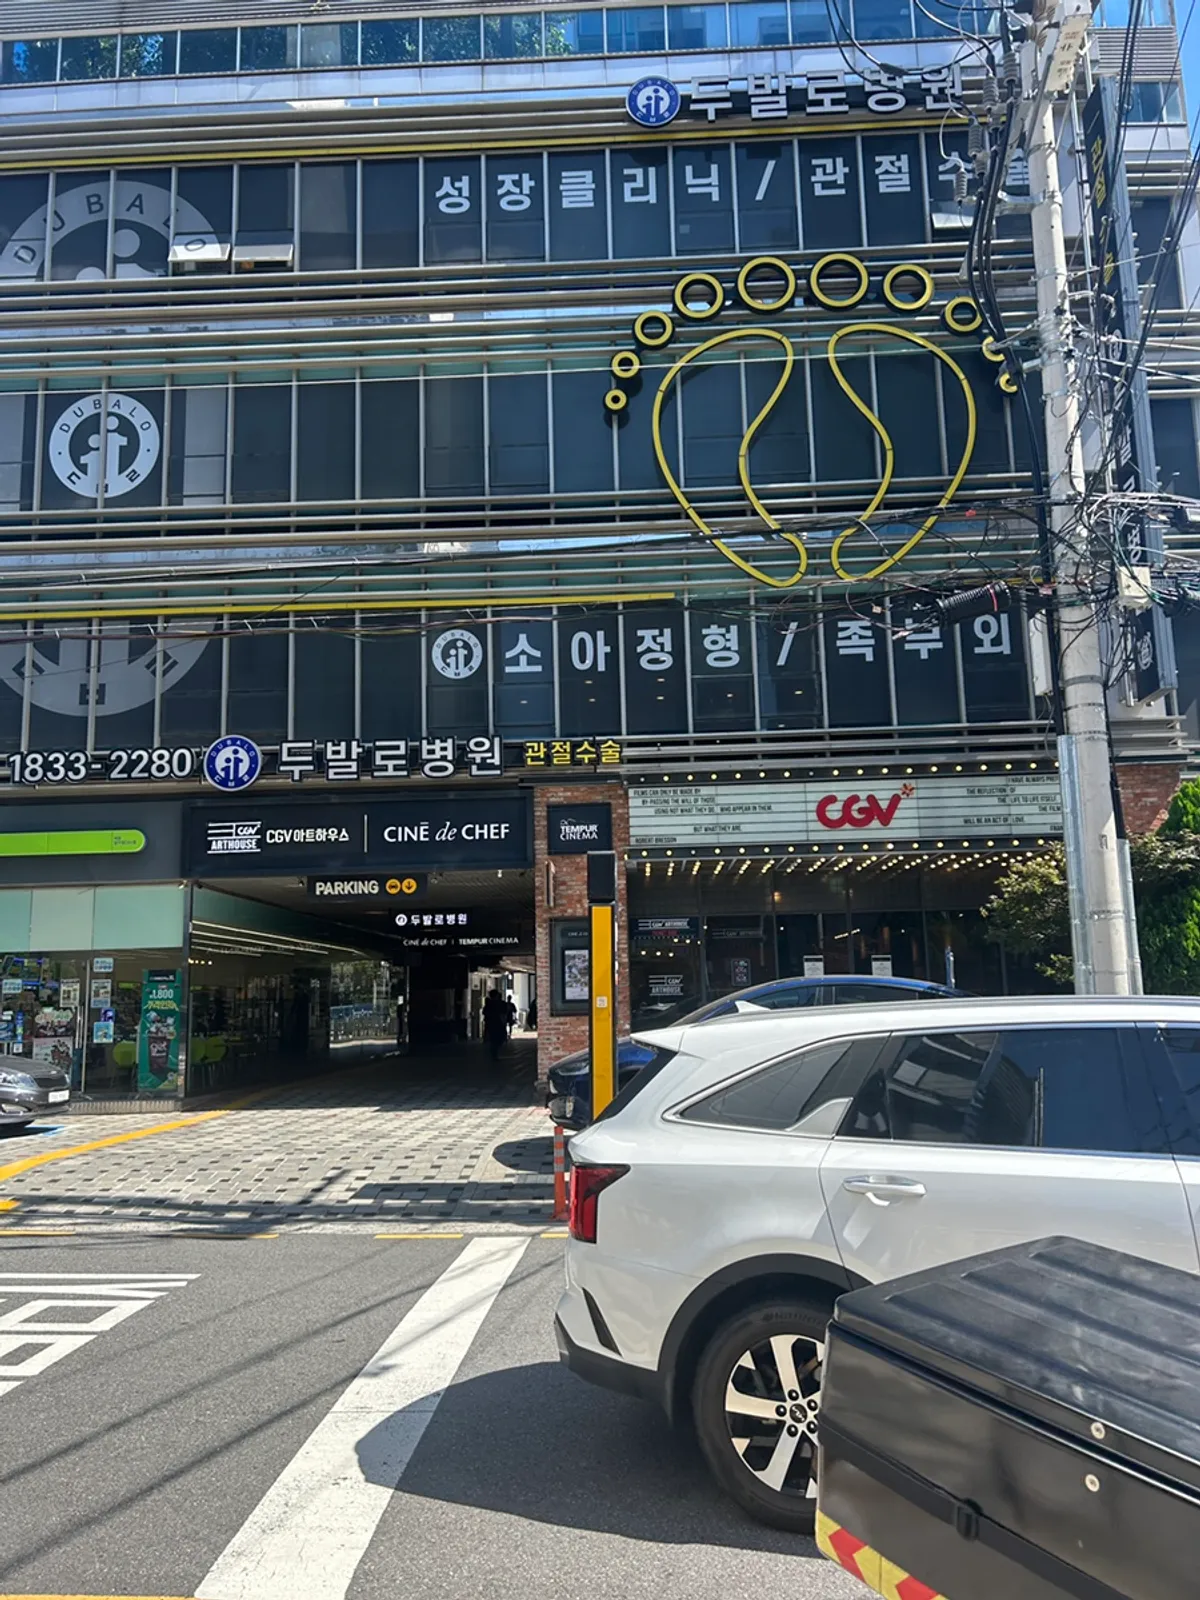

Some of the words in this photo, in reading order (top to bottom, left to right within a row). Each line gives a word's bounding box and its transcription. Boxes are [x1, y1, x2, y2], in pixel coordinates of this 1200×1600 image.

[690, 63, 963, 122] 두발로병원
[435, 164, 719, 214] 성장클리닉
[59, 398, 152, 434] DUBALO
[505, 624, 740, 674] 소아정형
[9, 747, 195, 783] 1833-2280
[279, 735, 501, 782] 두발로병원
[525, 739, 621, 766] 관절수술
[816, 793, 901, 828] CGV
[237, 824, 259, 835] CGV
[266, 827, 350, 844] CGV아트하우스
[435, 821, 458, 841] de
[461, 823, 510, 840] CHEF
[560, 831, 599, 842] CINEMA
[561, 823, 599, 834] TEMPUR
[210, 839, 258, 851] ARTHOUSE
[315, 880, 379, 896] PARKING
[411, 913, 468, 927] 두발로병원
[459, 937, 488, 946] TEMPUR
[488, 936, 519, 946] CINEMA
